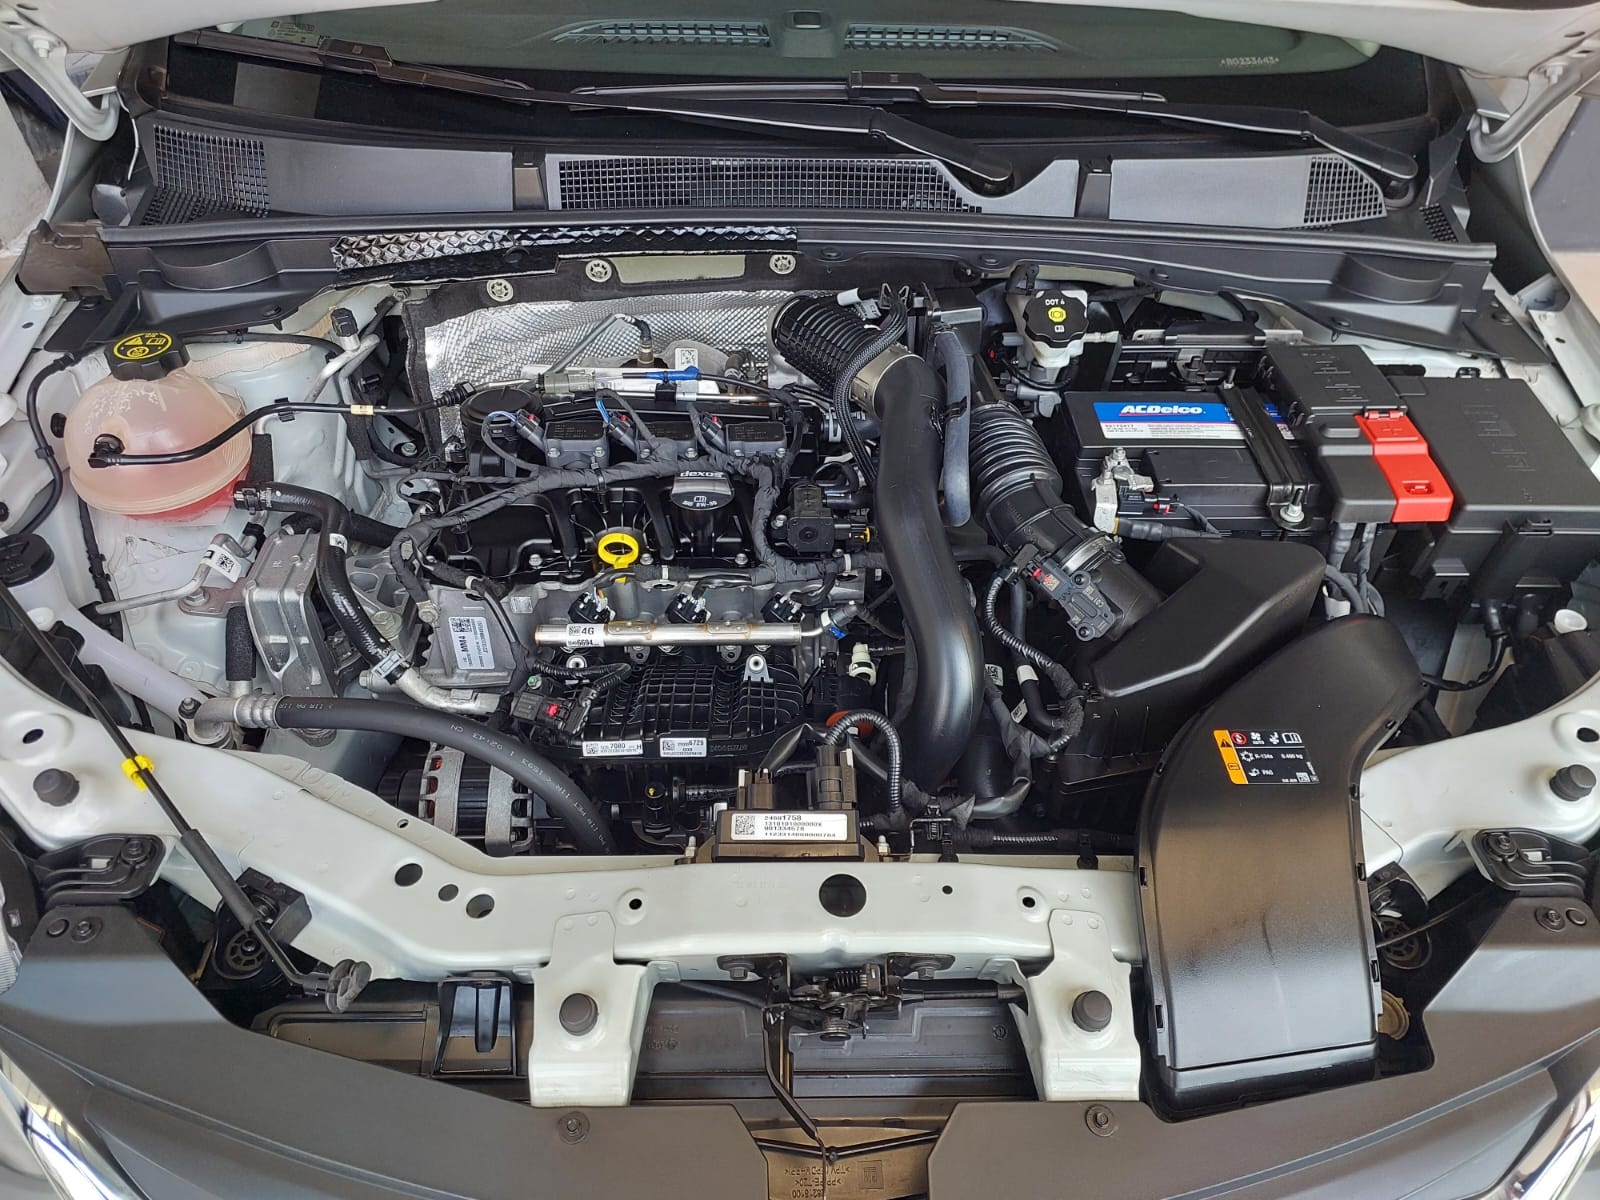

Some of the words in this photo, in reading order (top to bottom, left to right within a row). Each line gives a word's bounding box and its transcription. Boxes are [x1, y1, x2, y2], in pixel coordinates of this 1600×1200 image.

[1120, 405, 1203, 414] ACDelco
[582, 627, 594, 635] 4G
[458, 636, 468, 652] MM4
